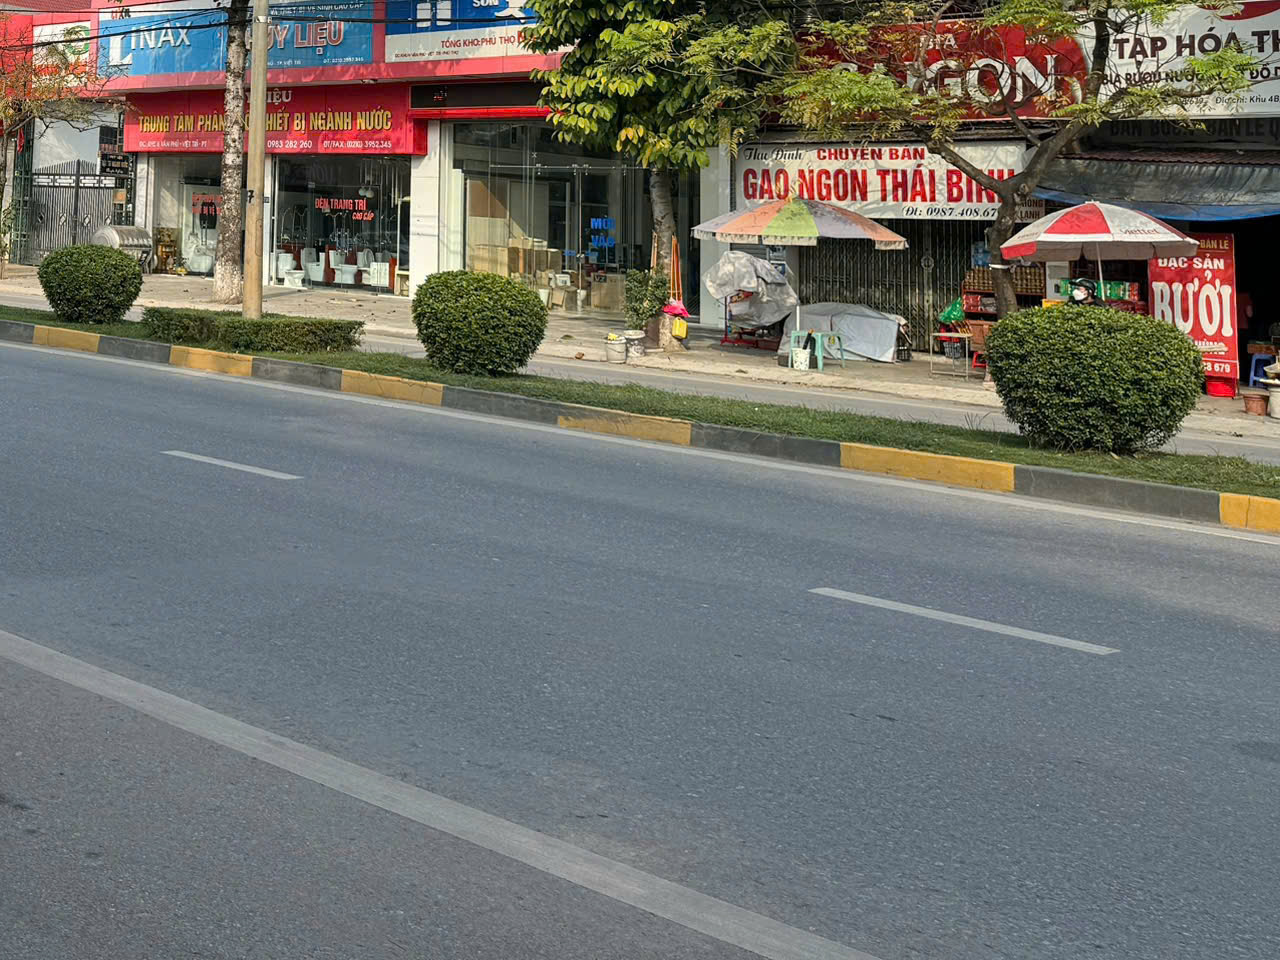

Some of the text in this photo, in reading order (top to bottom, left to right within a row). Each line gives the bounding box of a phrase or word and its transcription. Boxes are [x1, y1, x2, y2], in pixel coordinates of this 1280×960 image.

[131, 21, 193, 50] INAX
[266, 88, 292, 104] IỆU
[139, 115, 170, 133] TRUNG
[174, 111, 194, 133] TÂM
[265, 106, 290, 131] HIẾT
[294, 112, 306, 134] BỊ
[310, 108, 352, 131] NGÀNH
[357, 106, 392, 131] NƯỚC
[267, 139, 283, 149] 0983
[285, 139, 297, 149] 282
[299, 139, 312, 149] 260
[817, 143, 882, 161] CHUYÊN
[889, 144, 925, 161] BÁN
[798, 168, 868, 202] NGON
[876, 163, 937, 203] THÁI
[926, 207, 999, 218] 0987.408.67
[1193, 253, 1225, 270] SẢN
[1152, 270, 1234, 337] BƯỞI
